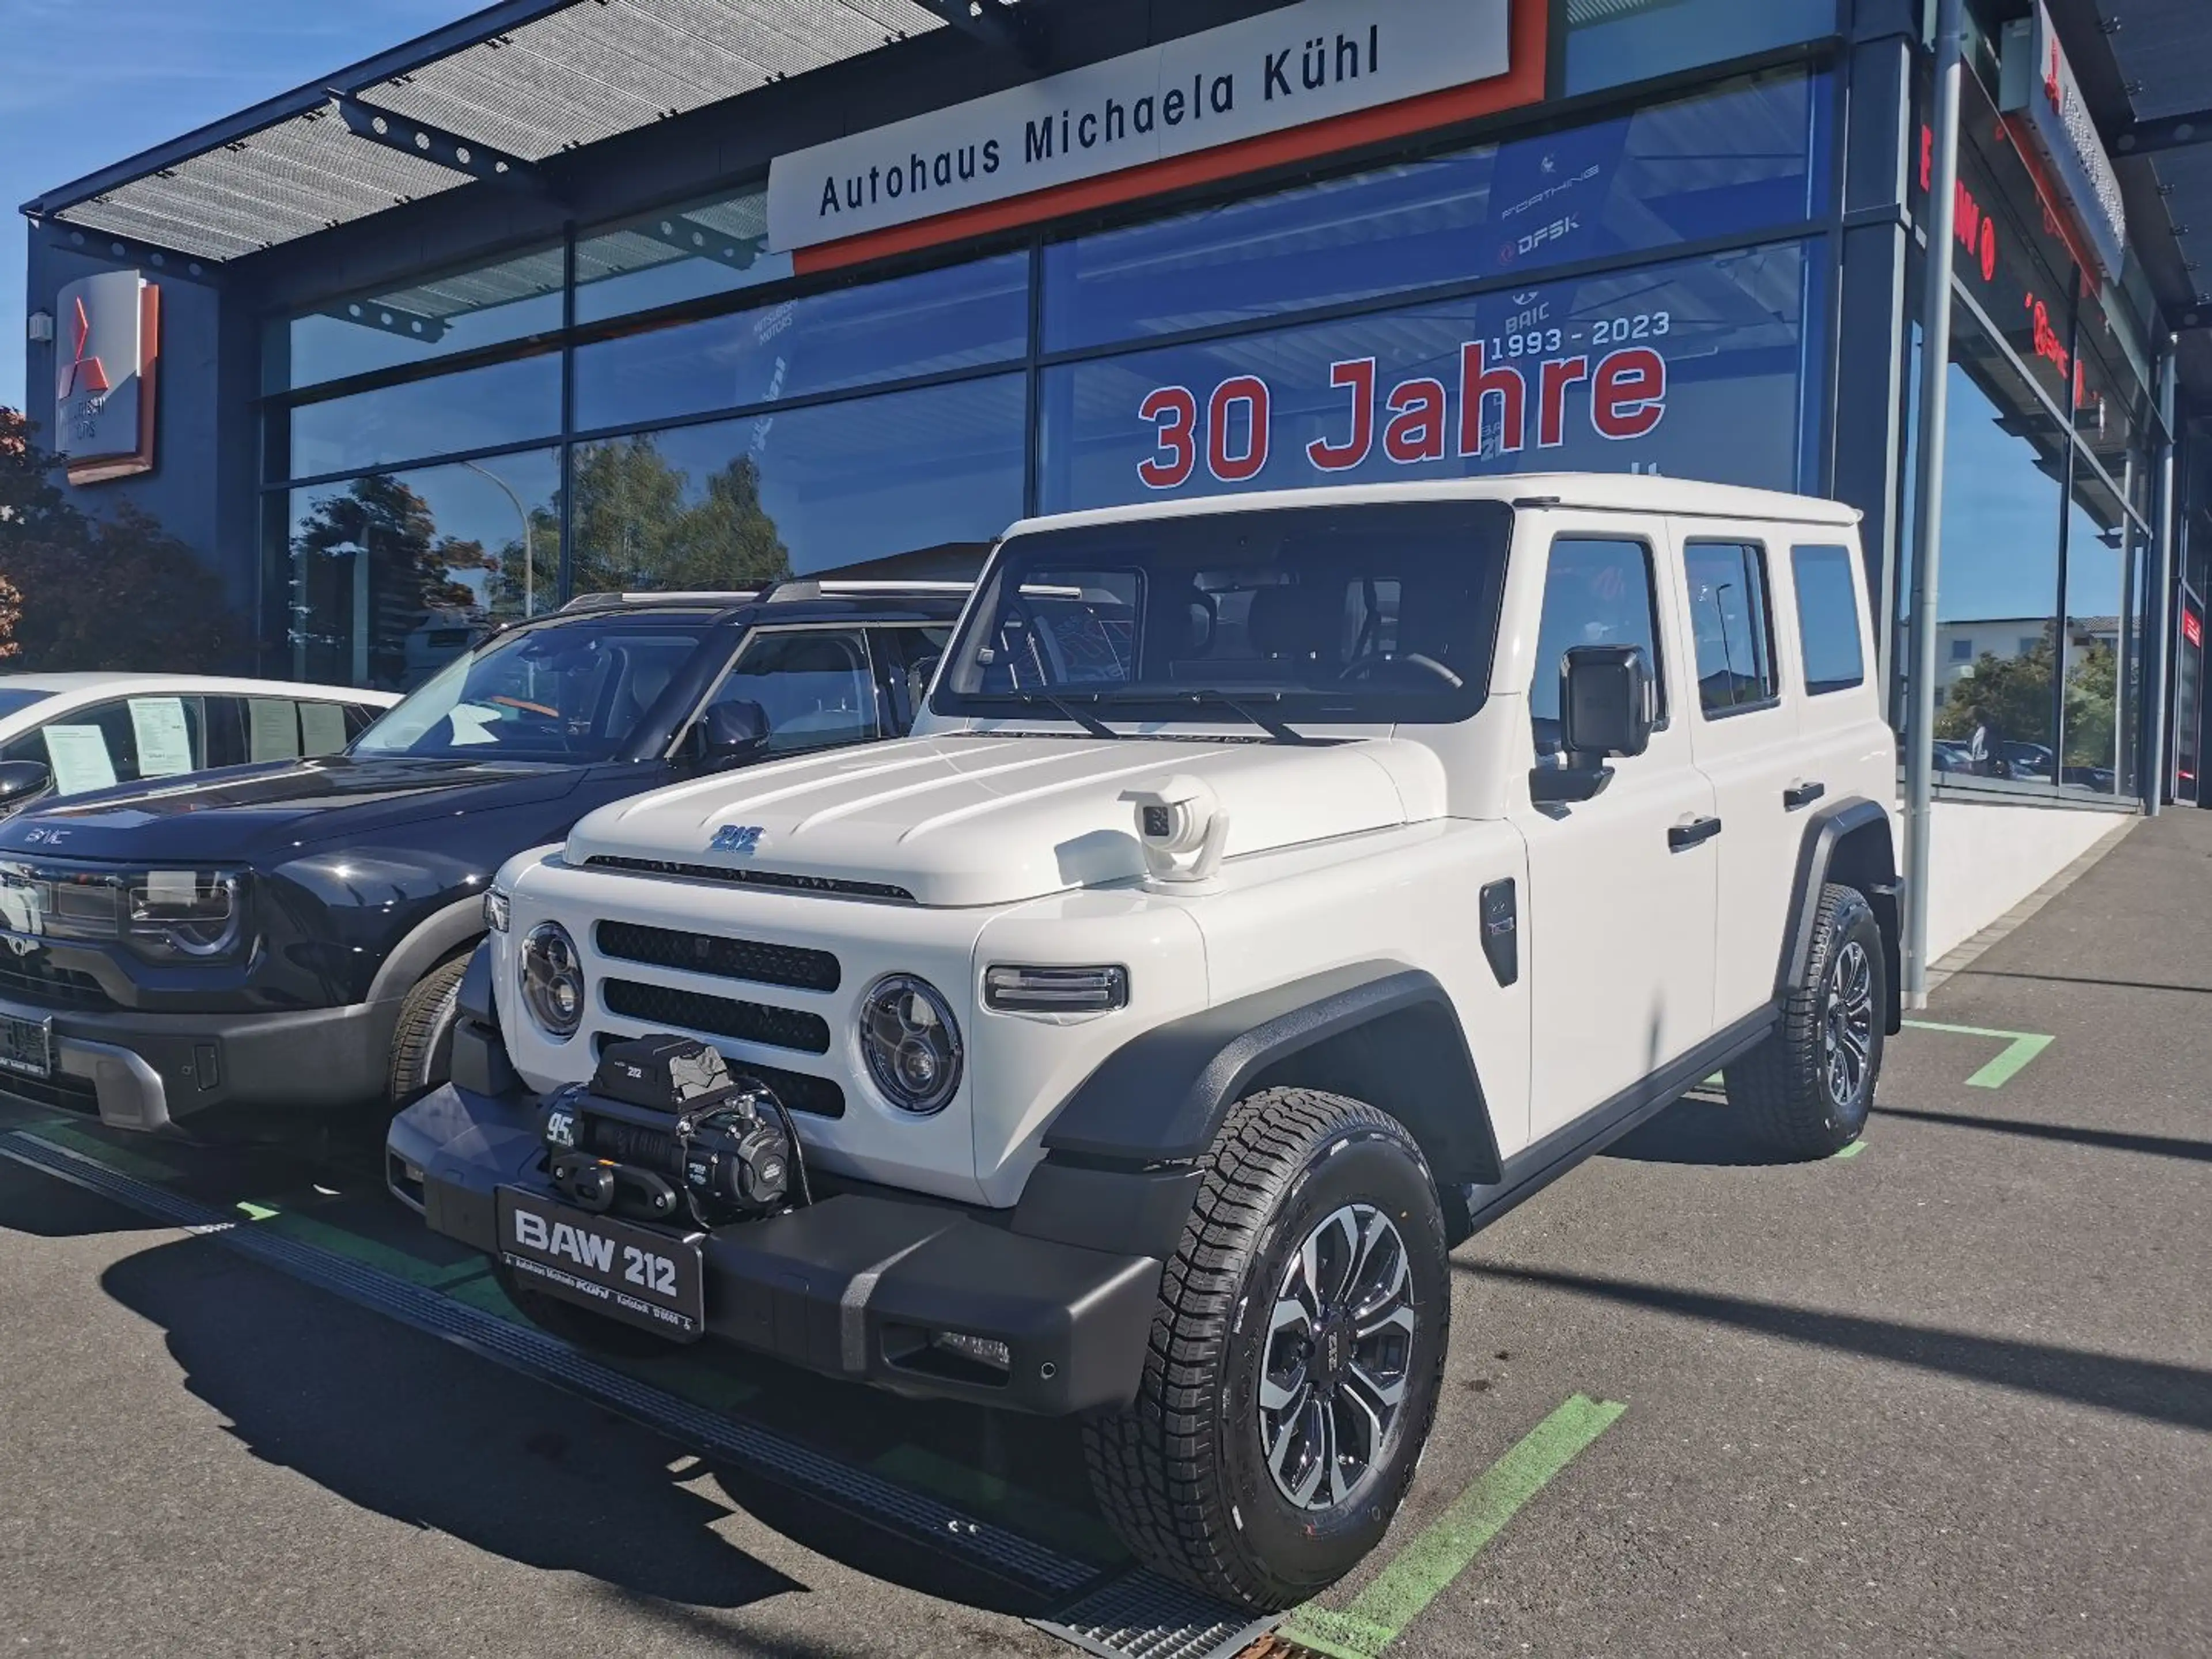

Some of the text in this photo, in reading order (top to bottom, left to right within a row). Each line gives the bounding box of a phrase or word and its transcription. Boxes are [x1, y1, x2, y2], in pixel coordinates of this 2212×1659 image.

[819, 24, 1378, 217] Autohaus Michaela Kühl
[1517, 211, 1580, 255] DFSK
[1491, 328, 1562, 361] 1993
[1592, 311, 1670, 345] 2023
[1505, 301, 1550, 335] BAIC
[1136, 339, 1666, 490] 30 Jahre
[709, 824, 764, 853] 212
[626, 1066, 642, 1078] 212
[515, 1209, 677, 1297] BAW 212
